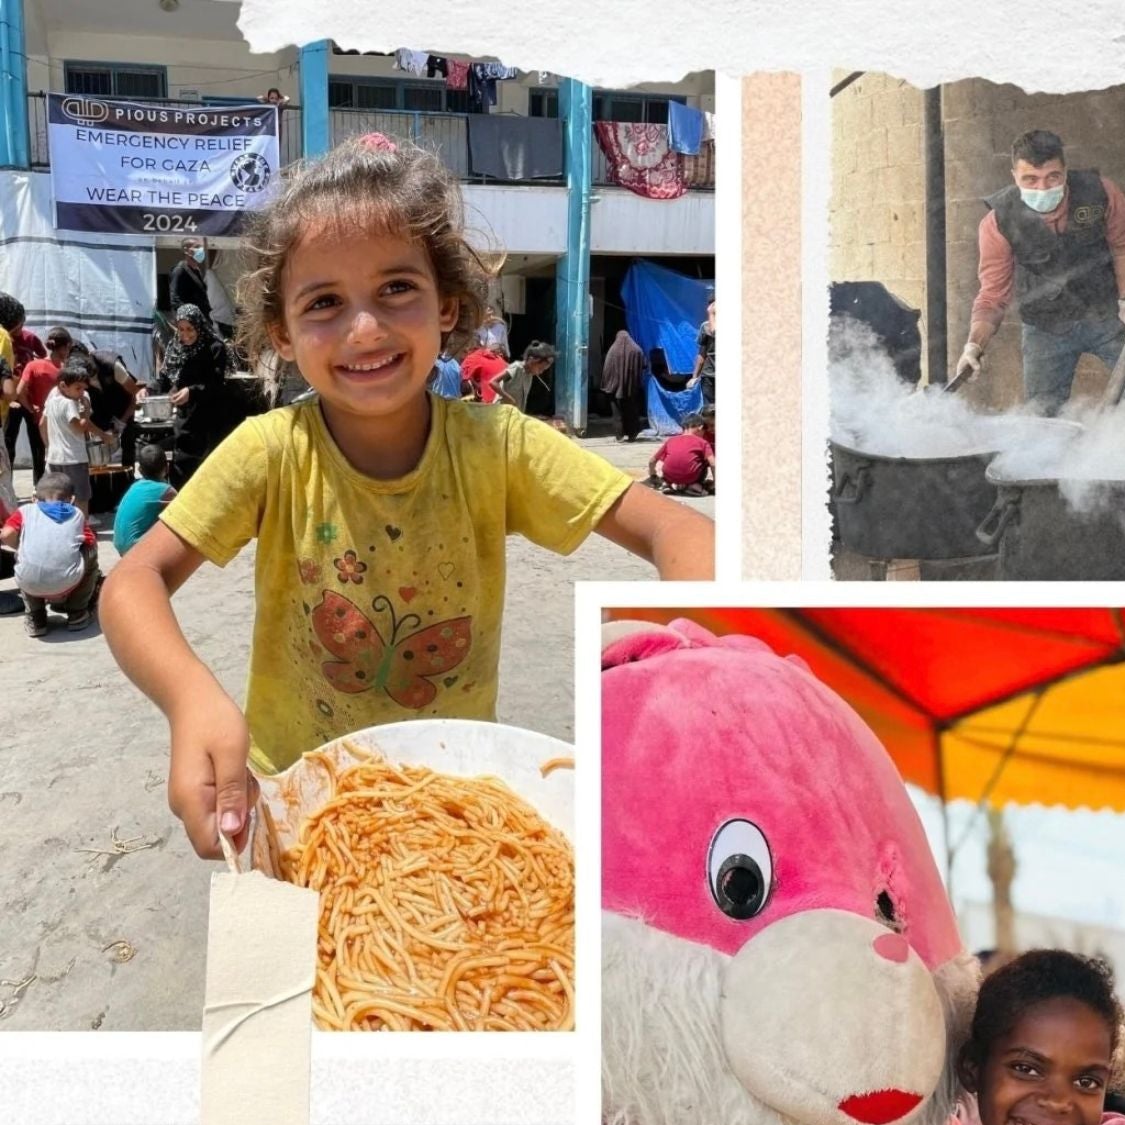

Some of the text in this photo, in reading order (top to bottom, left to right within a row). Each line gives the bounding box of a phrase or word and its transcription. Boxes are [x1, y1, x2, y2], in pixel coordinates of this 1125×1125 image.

[115, 108, 262, 127] PIOUS PROJECTS
[76, 129, 252, 151] EMERGENCY RELIEF
[121, 156, 211, 173] FOR GAZA
[86, 187, 245, 207] WEAR THE PEACE
[143, 213, 198, 232] 2024
